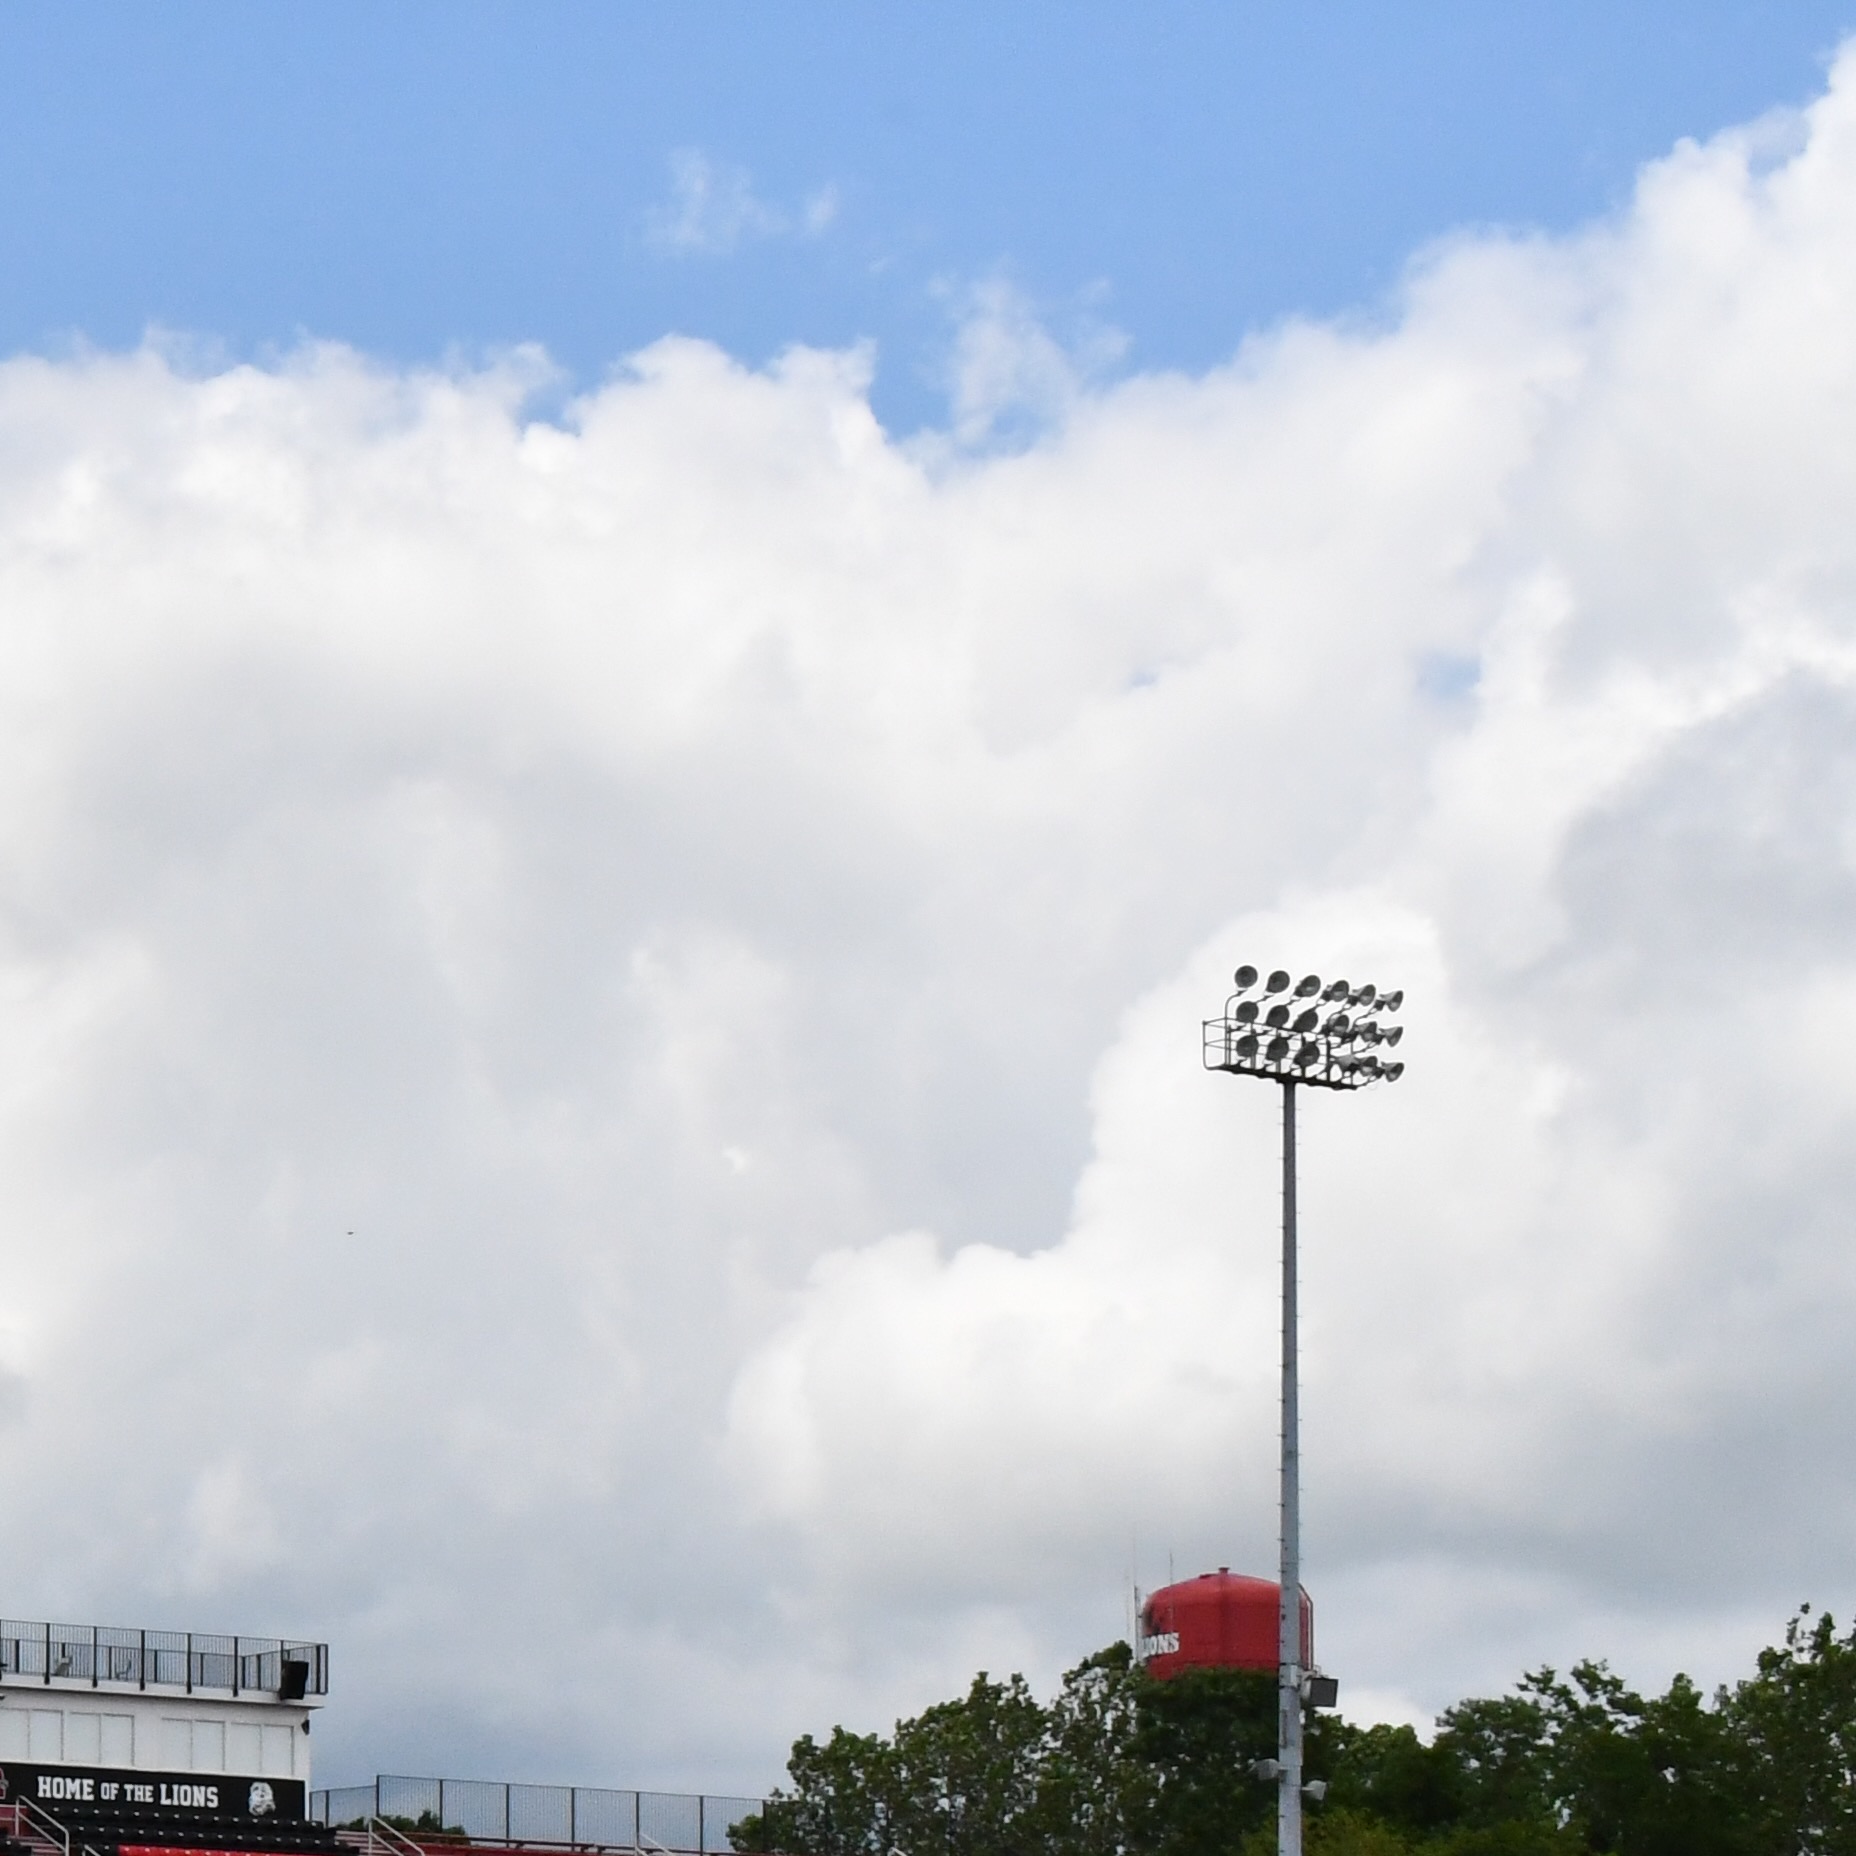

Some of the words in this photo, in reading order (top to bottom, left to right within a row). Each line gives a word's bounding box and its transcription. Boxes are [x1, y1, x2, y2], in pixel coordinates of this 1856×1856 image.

[37, 1775, 95, 1801] HOME
[100, 1782, 119, 1801] OF
[124, 1783, 154, 1803] THE
[159, 1784, 219, 1808] LIONS
